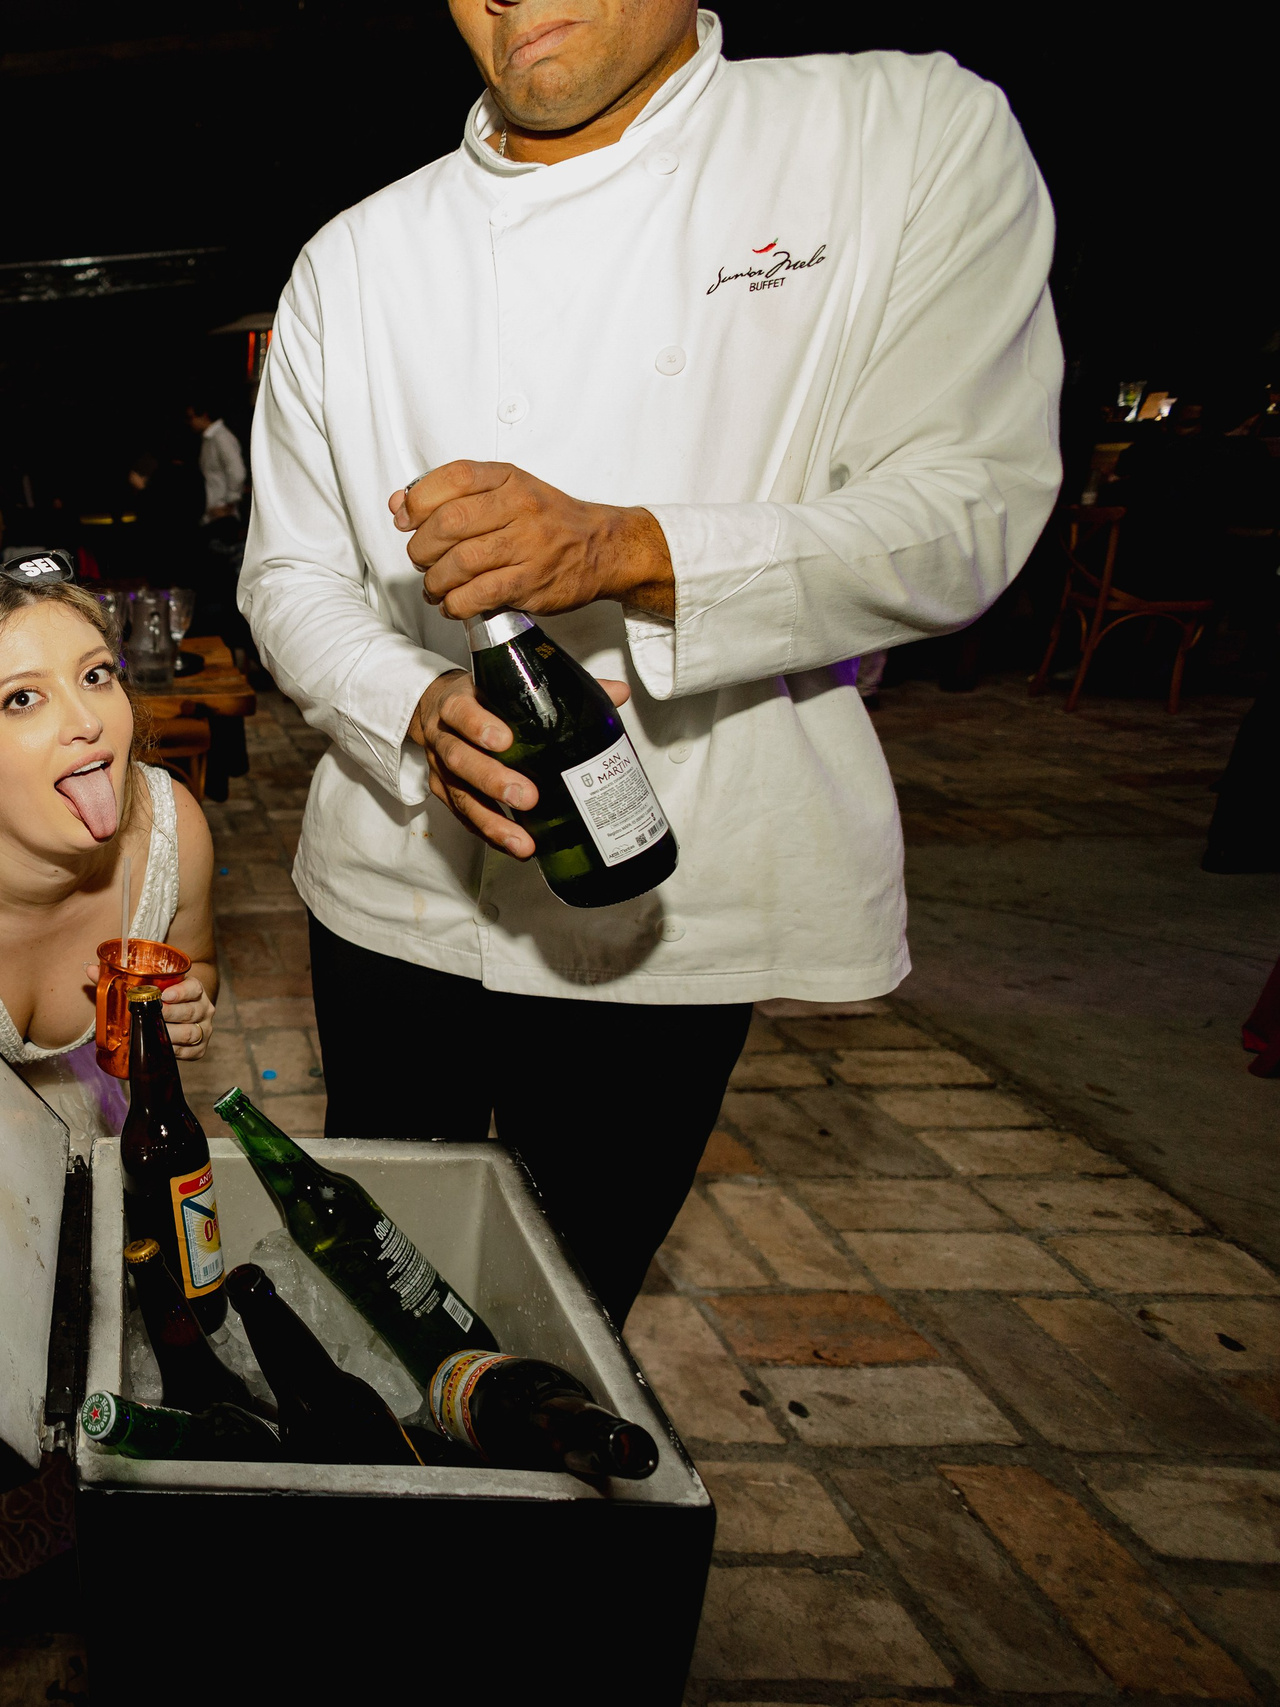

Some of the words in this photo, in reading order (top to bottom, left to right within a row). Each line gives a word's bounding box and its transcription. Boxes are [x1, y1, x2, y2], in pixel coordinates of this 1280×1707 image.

[706, 266, 765, 295] Junior
[764, 244, 827, 279] Melo
[749, 277, 786, 292] BUFFET
[19, 557, 61, 578] SEI
[597, 757, 631, 784] MARTIN
[602, 752, 621, 770] SAN
[88, 1398, 110, 1432] Heineken
